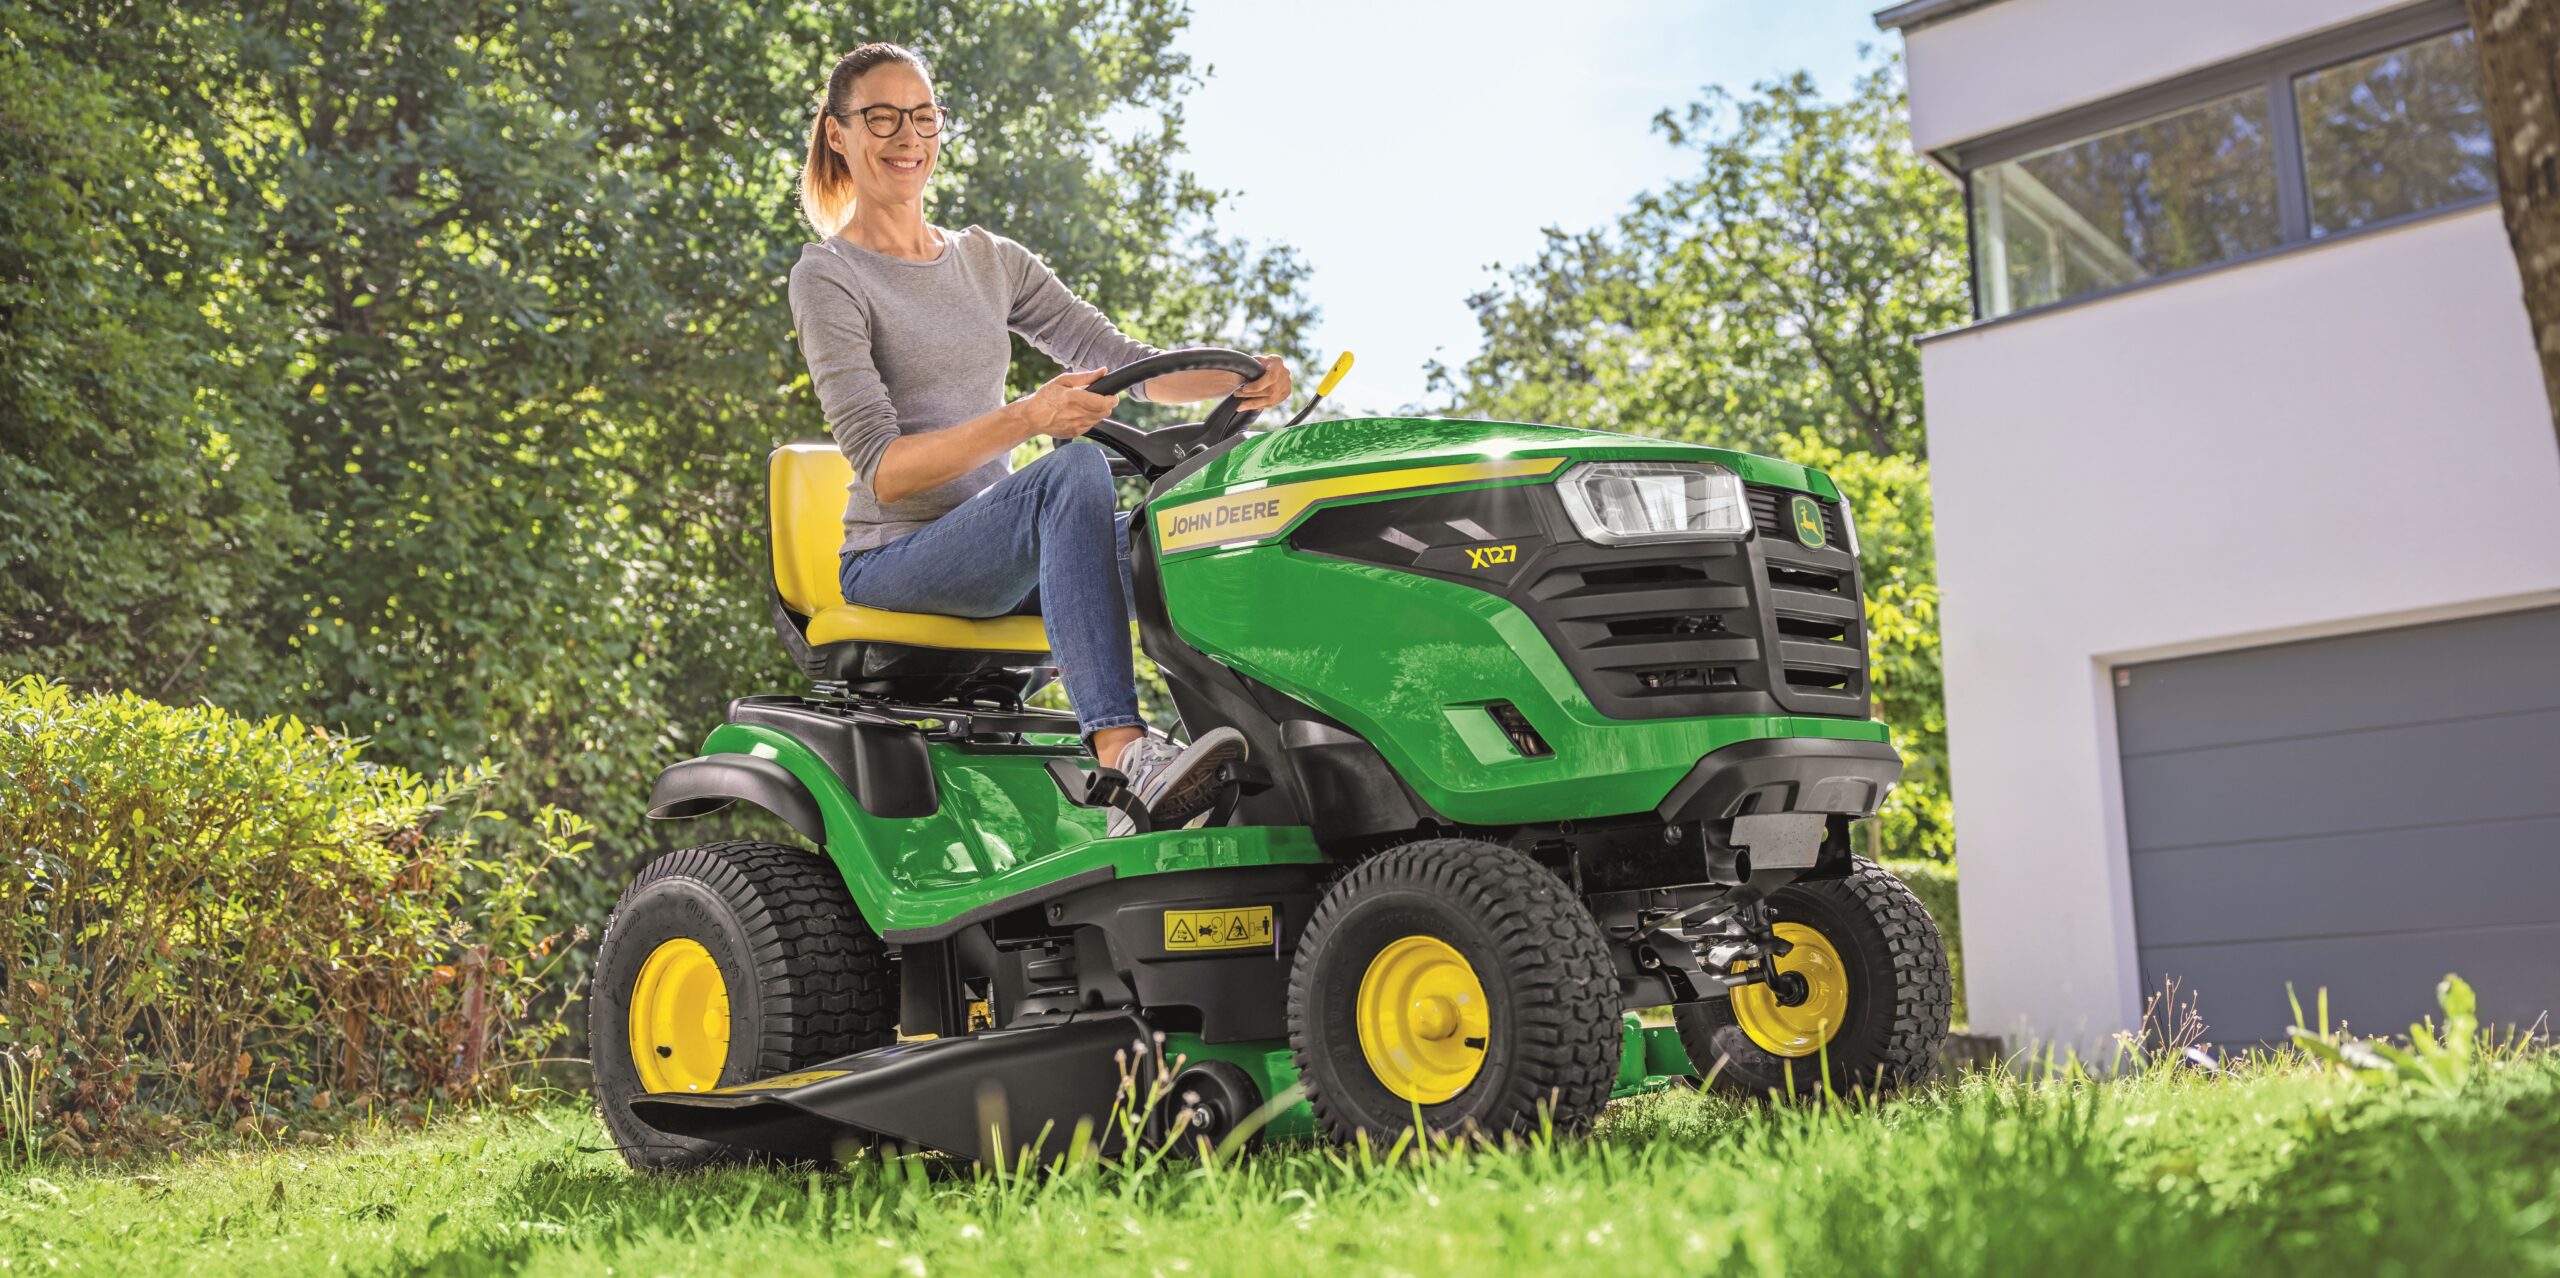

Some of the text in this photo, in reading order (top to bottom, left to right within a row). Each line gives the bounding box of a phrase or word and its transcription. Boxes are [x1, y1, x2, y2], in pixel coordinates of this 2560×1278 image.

[1168, 499, 1280, 537] JOHN DEERE
[1465, 544, 1517, 569] X127
